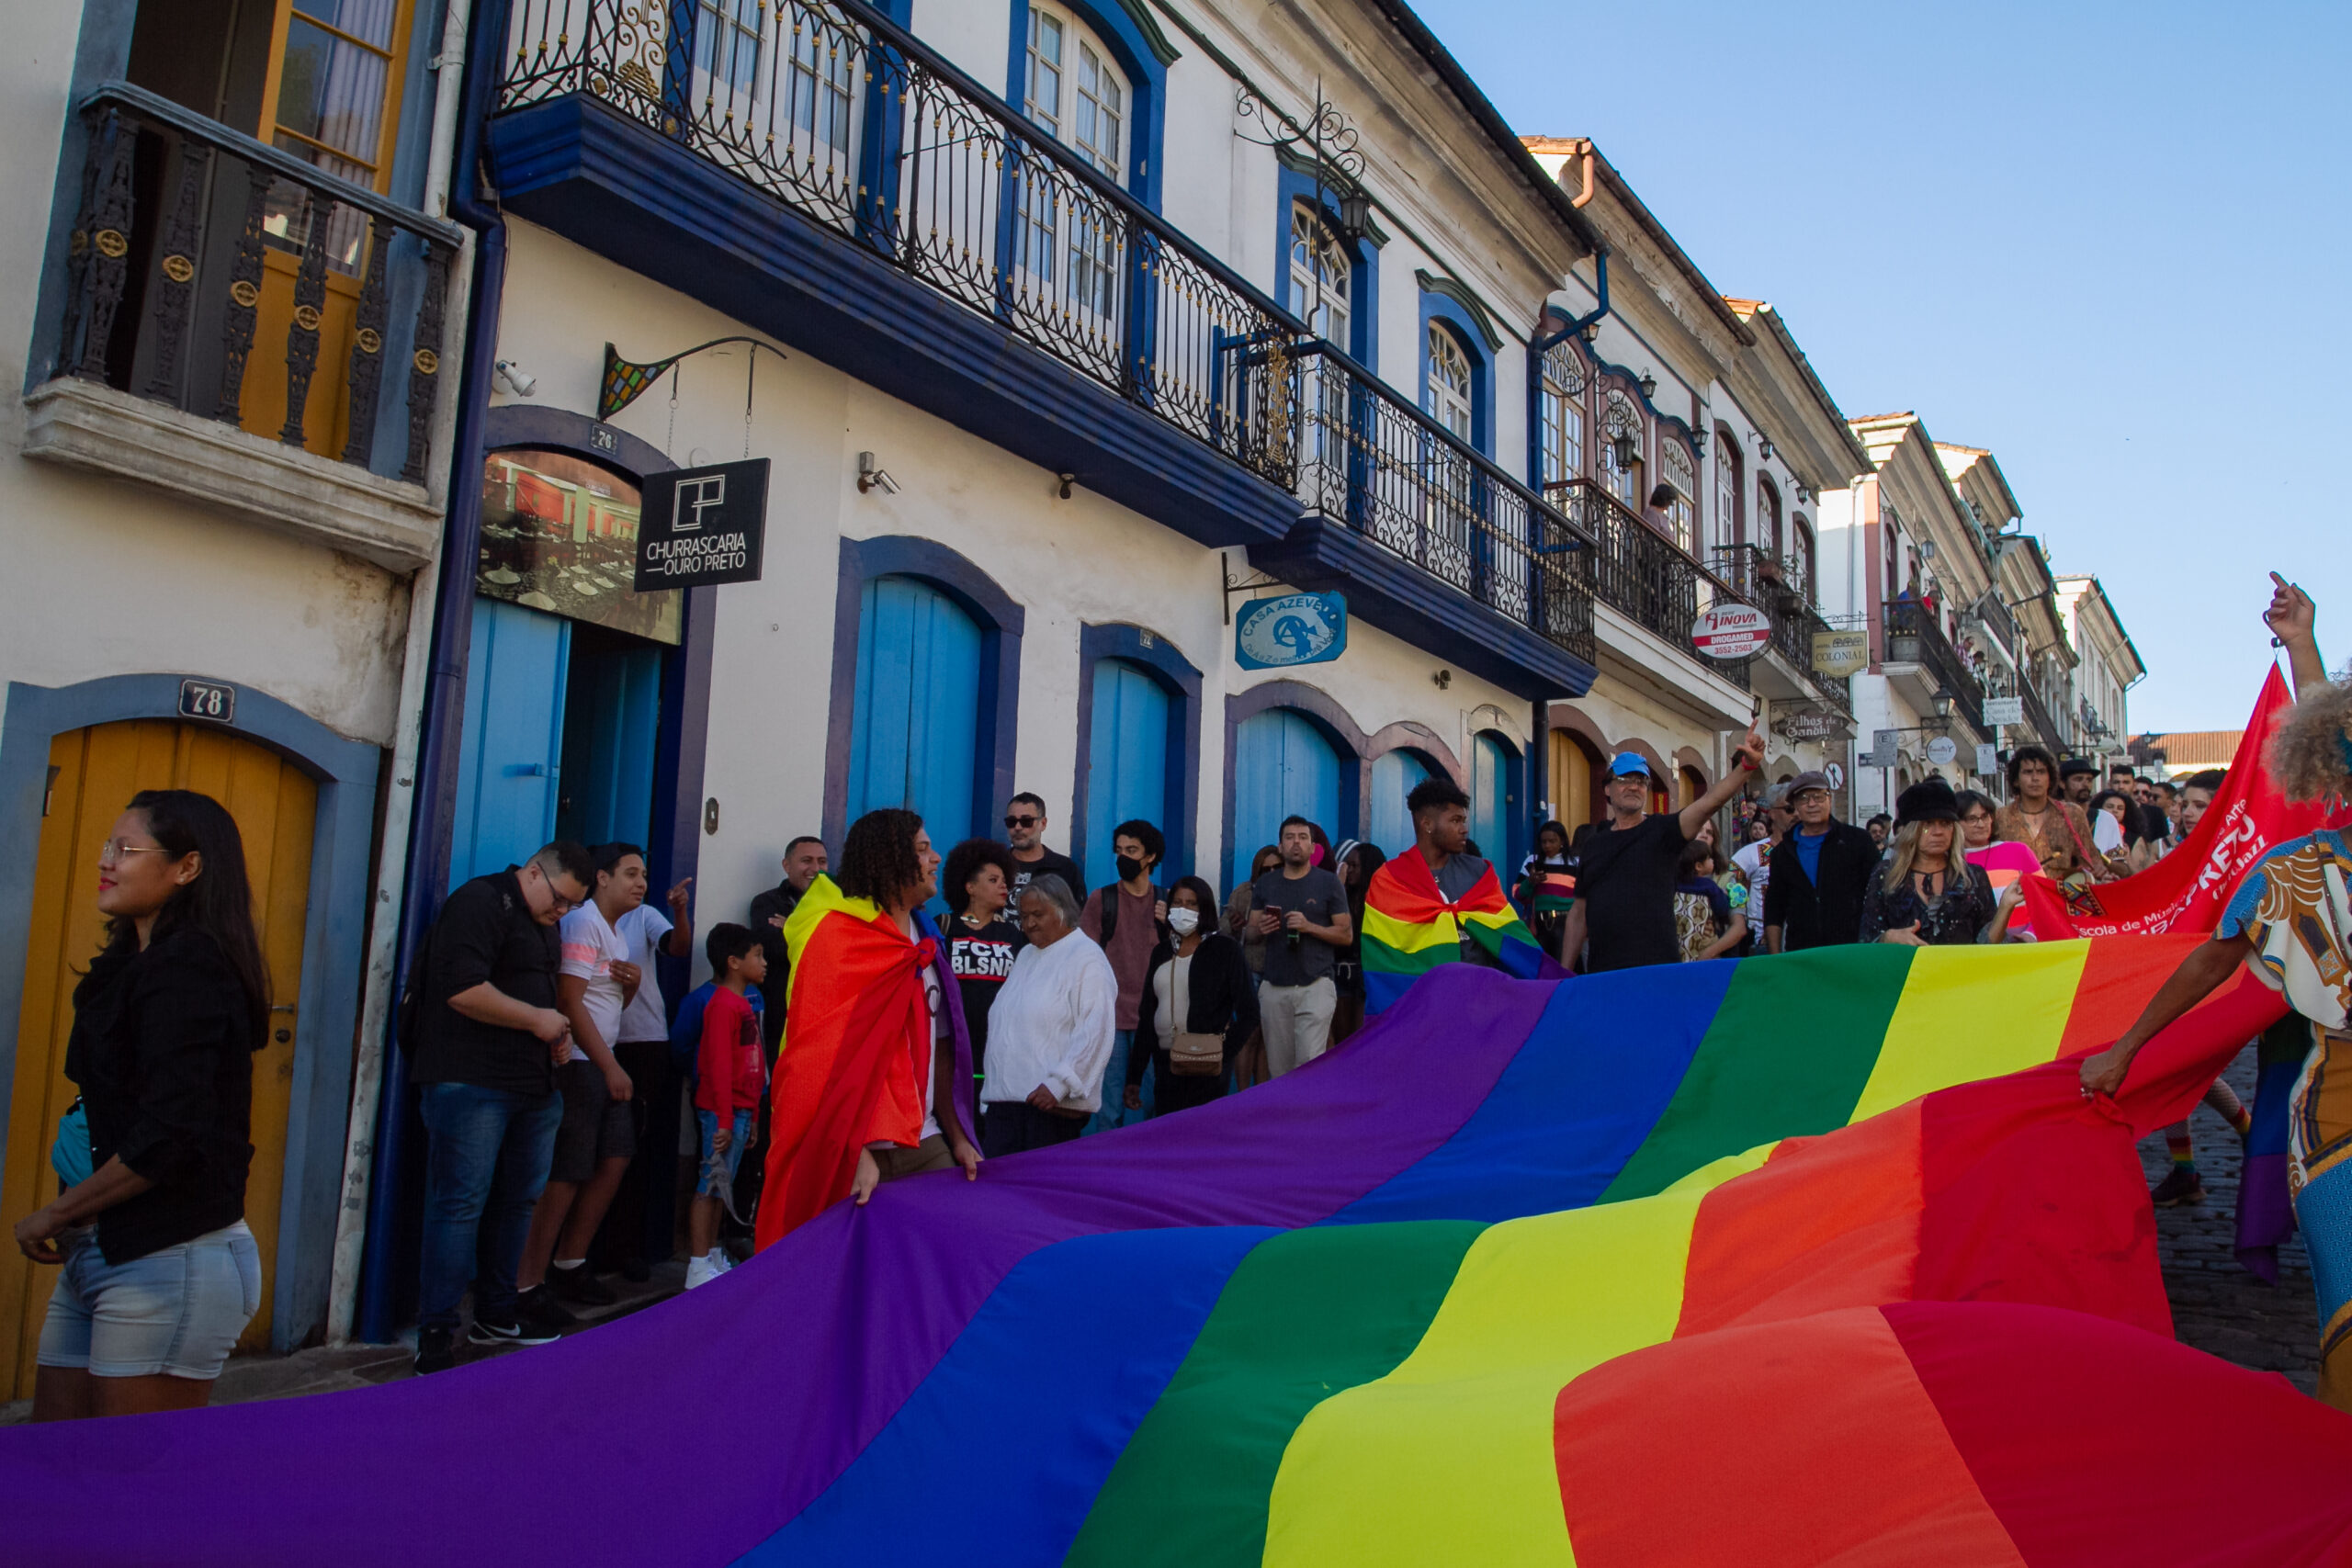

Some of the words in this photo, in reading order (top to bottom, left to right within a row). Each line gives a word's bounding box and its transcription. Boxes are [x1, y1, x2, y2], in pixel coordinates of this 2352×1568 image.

[598, 430, 612, 448] 76
[646, 532, 746, 560] CHURRASCARIA
[664, 556, 701, 576] OURO
[704, 552, 746, 571] PRETO
[1243, 606, 1274, 637] CASA
[1719, 613, 1757, 626] INOVA
[1711, 632, 1754, 644] DROGAMED
[1815, 650, 1864, 662] COLONIAL
[193, 686, 222, 716] 78
[1785, 715, 1823, 728] Filhos
[1786, 725, 1830, 738] Gandhi
[1881, 735, 1888, 743] E
[2121, 921, 2141, 931] de
[952, 940, 1014, 960] FCK
